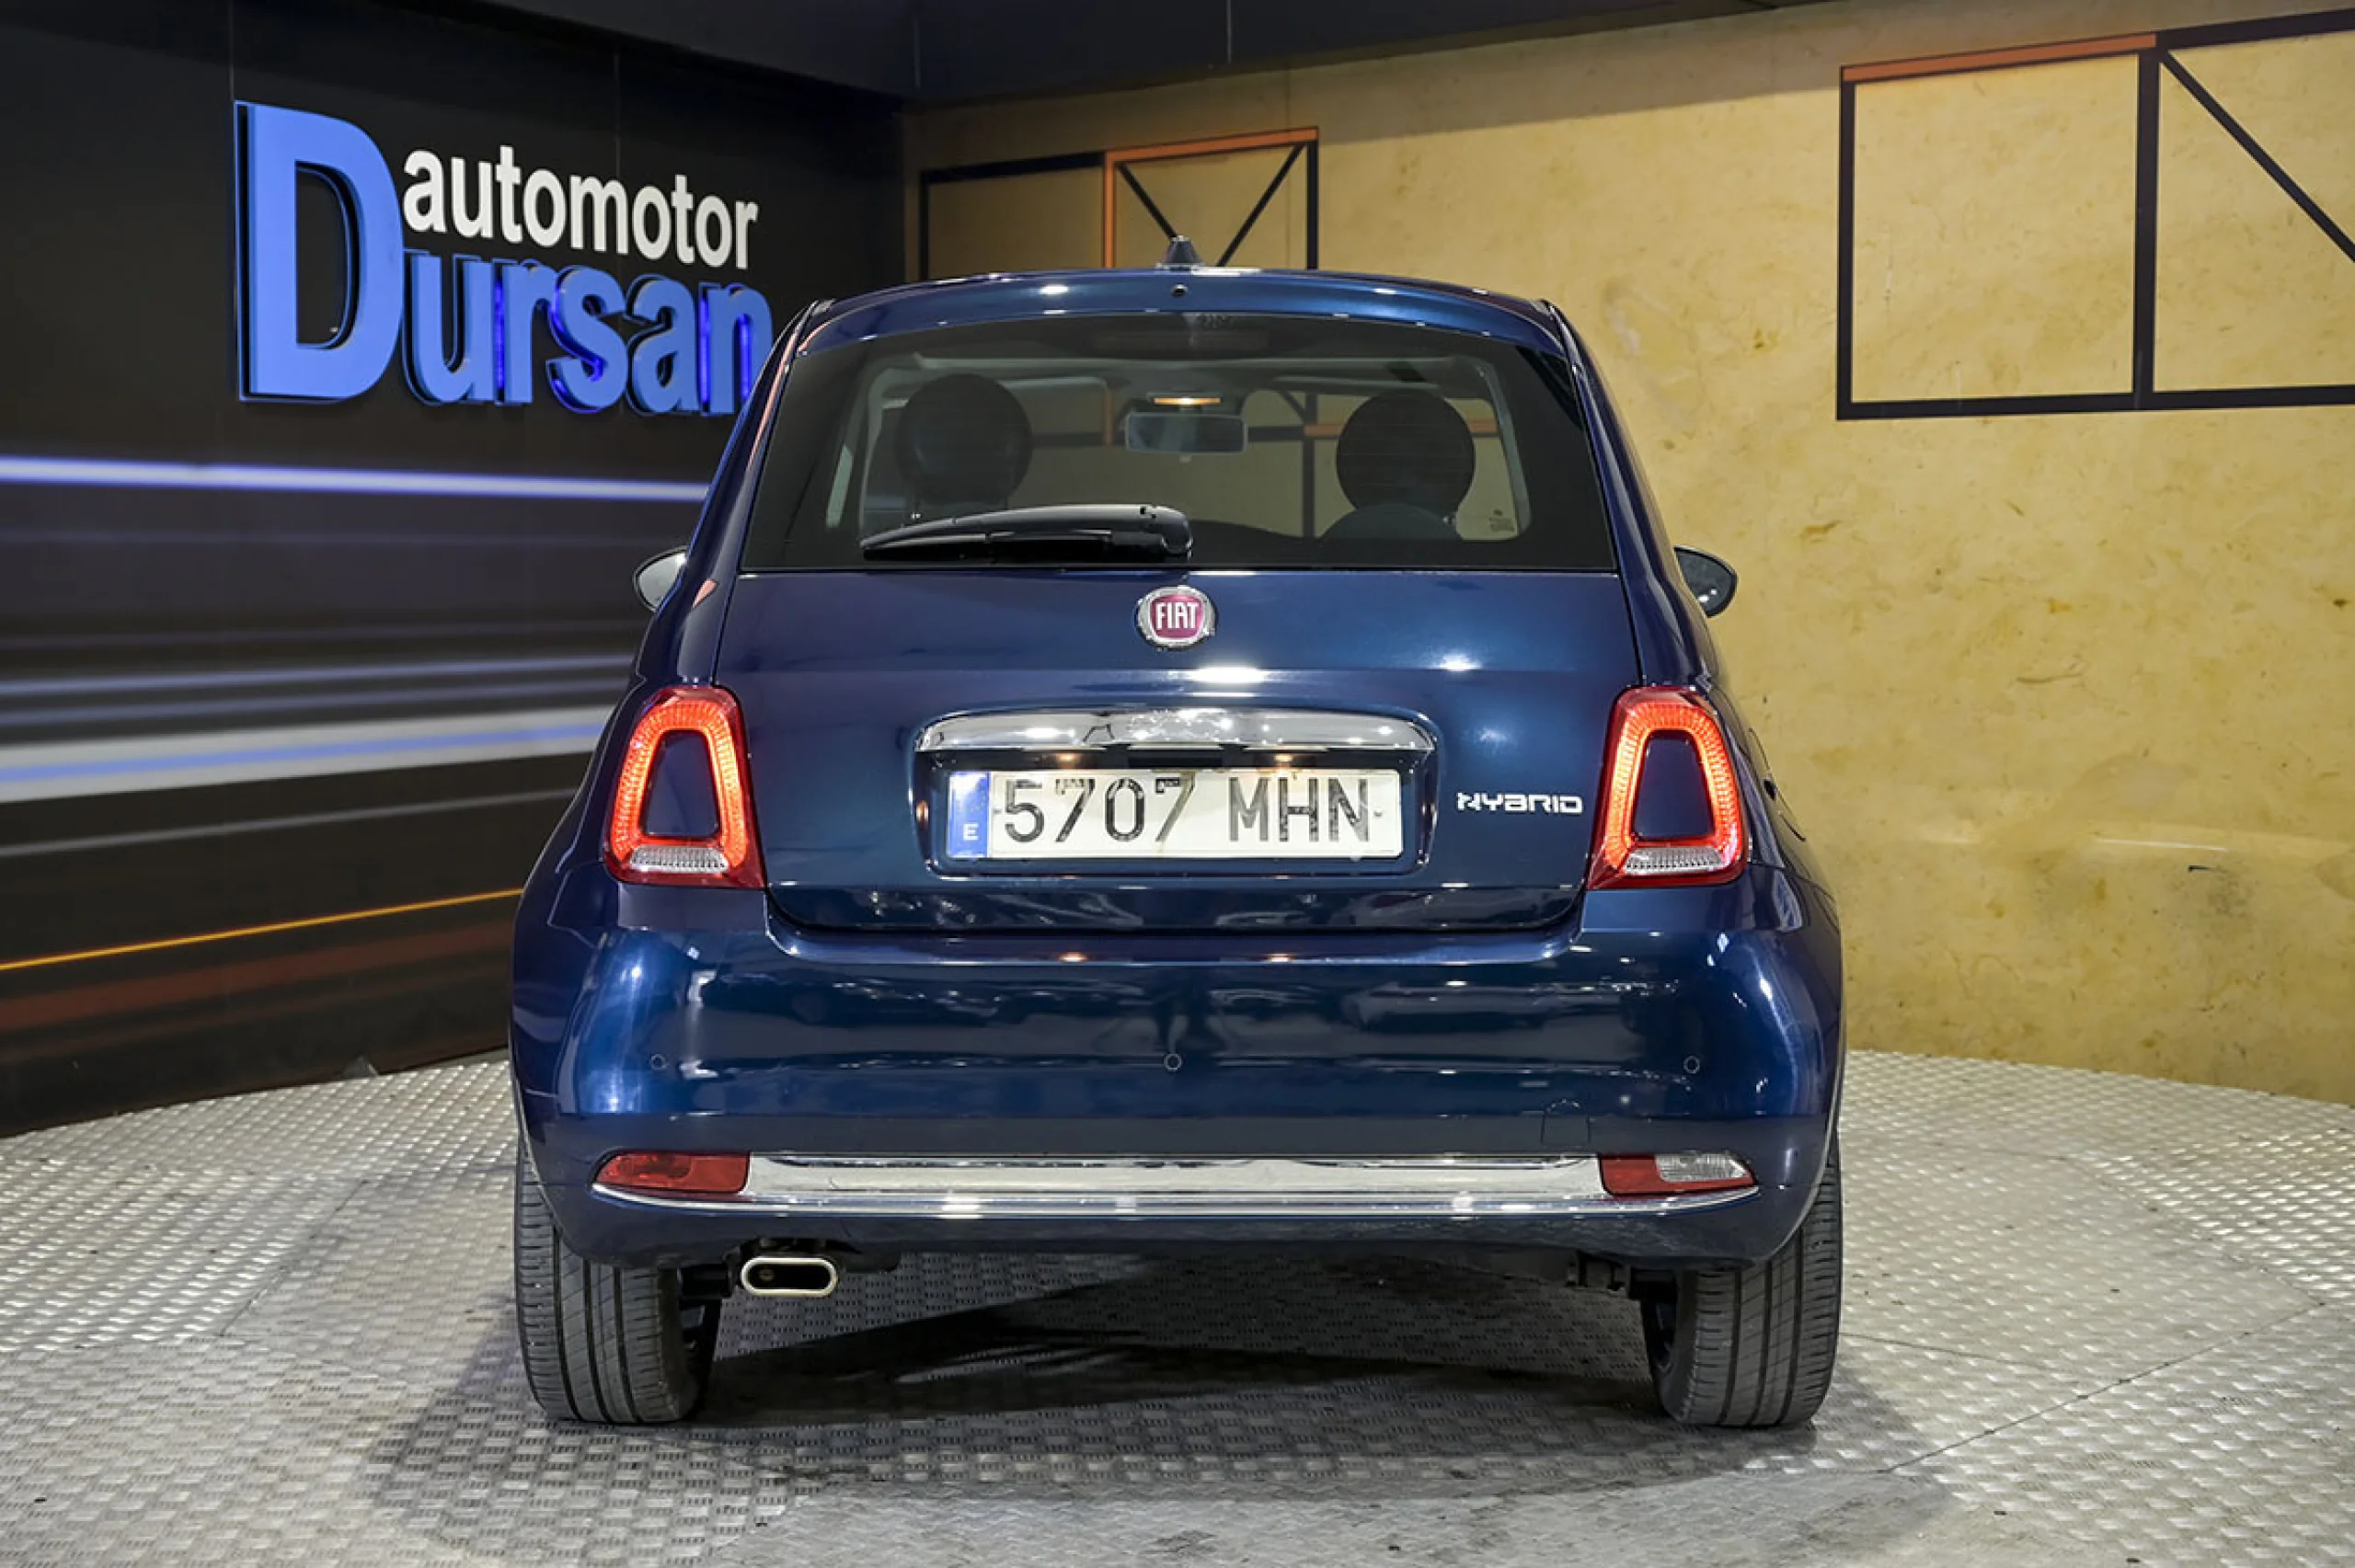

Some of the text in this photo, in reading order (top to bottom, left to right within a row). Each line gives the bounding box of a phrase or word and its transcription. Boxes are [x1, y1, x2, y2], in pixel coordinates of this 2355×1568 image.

[403, 145, 759, 269] automotor
[234, 100, 774, 416] Dursan
[1155, 601, 1200, 630] FIAT
[1005, 775, 1370, 842] 5707 MHN
[1456, 792, 1583, 814] HYBRID
[963, 823, 979, 841] E
